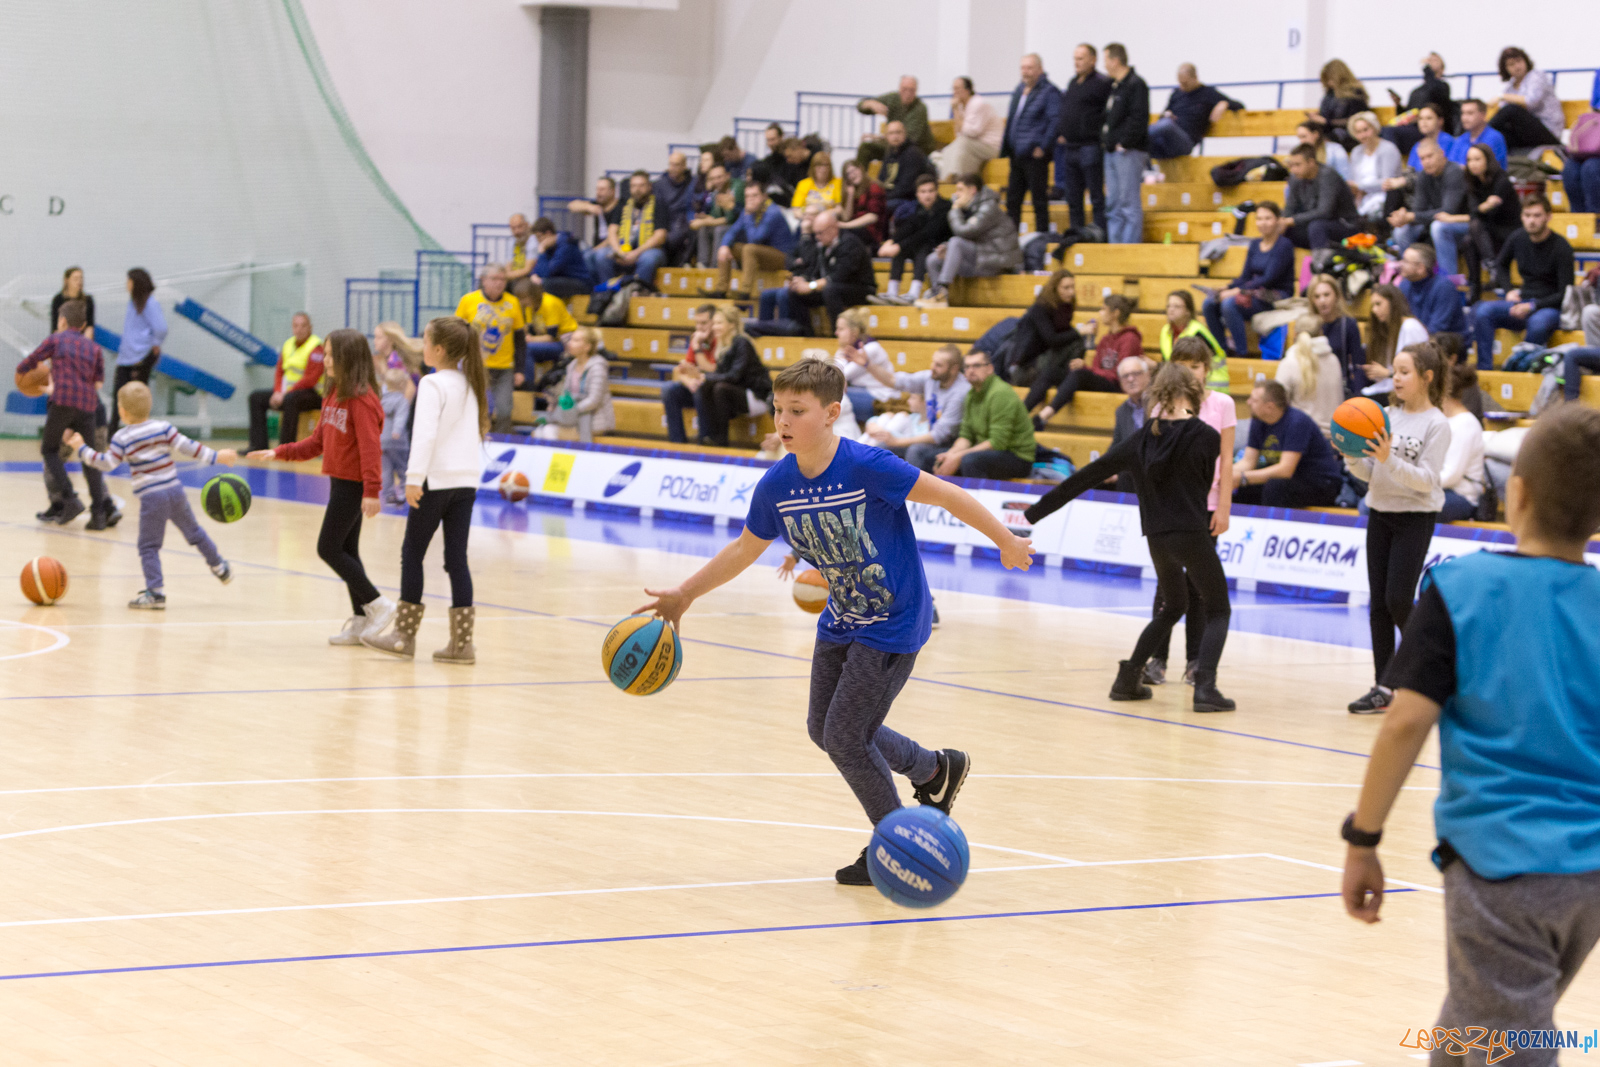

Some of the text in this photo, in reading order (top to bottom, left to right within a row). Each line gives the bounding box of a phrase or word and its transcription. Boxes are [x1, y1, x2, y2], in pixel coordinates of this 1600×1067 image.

[48, 195, 66, 217] D
[1262, 534, 1361, 568] BIOFARM
[875, 844, 933, 893] KIPSTA
